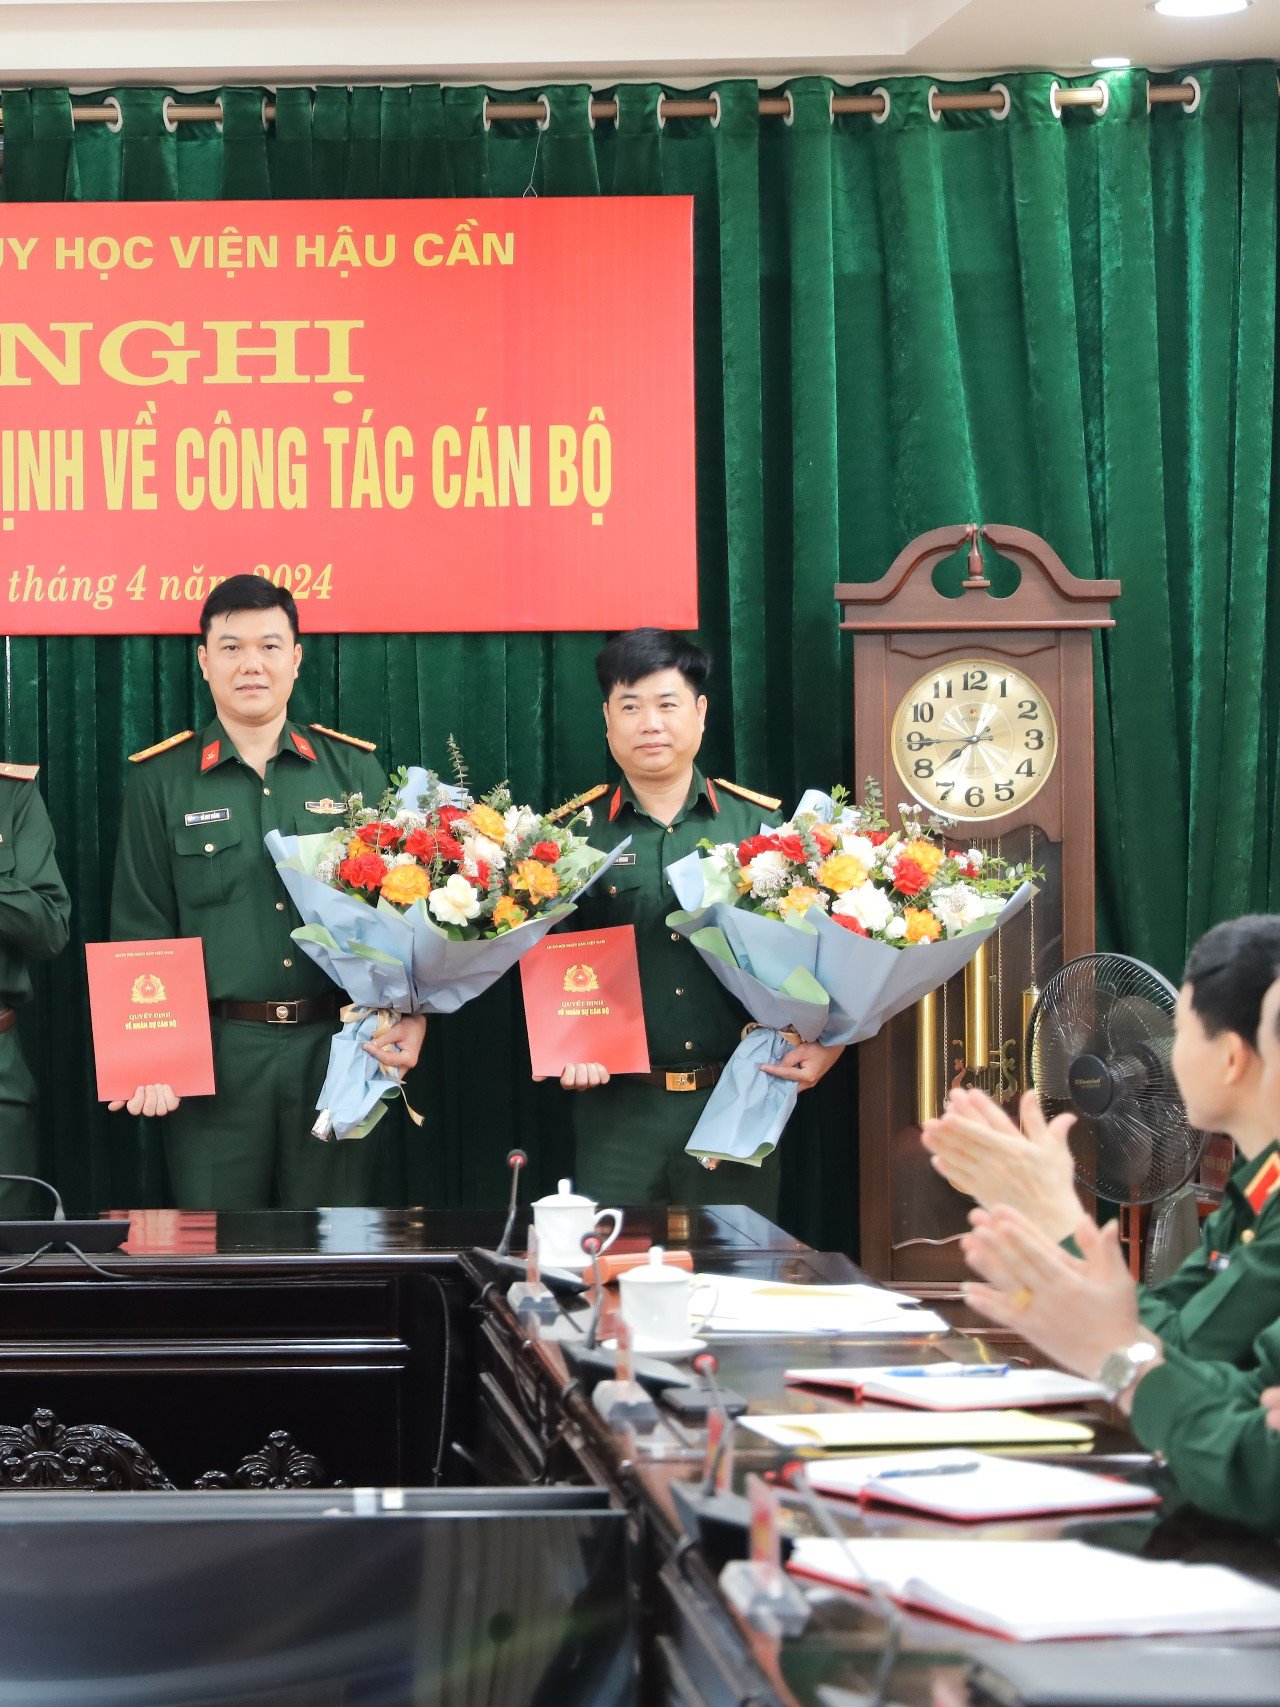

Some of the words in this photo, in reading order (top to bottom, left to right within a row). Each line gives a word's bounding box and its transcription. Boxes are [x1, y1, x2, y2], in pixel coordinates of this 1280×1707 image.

[55, 236, 154, 281] HỌC
[169, 227, 278, 278] VIỆN
[296, 226, 396, 278] HẬU
[413, 218, 515, 267] CẦN
[99, 400, 158, 511] VỀ
[175, 409, 308, 511] CÔNG
[322, 408, 415, 510] TÁC
[431, 406, 532, 508] CÁN
[548, 405, 612, 526] BỘ
[7, 564, 118, 611] tháng
[125, 564, 147, 601] 4
[933, 679, 953, 698] 11
[962, 670, 988, 690] 12
[1000, 678, 1007, 697] 1
[912, 702, 934, 723] 10
[1018, 700, 1038, 720] 2
[907, 731, 924, 751] 9
[1024, 729, 1044, 750] 3
[914, 759, 934, 778] 8
[1015, 758, 1036, 777] 4
[936, 781, 955, 800] 7
[965, 786, 985, 807] 6
[995, 779, 1014, 801] 5
